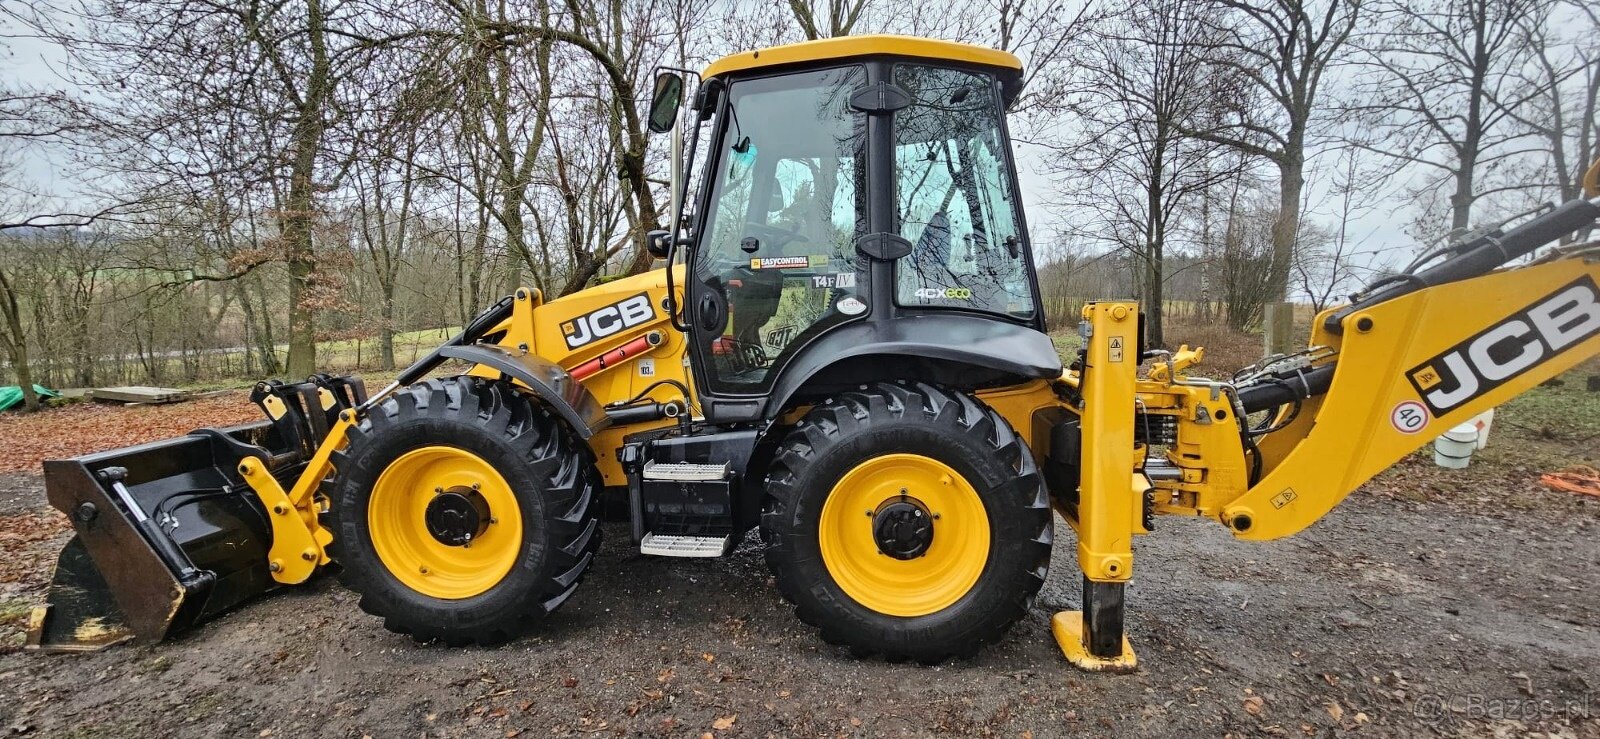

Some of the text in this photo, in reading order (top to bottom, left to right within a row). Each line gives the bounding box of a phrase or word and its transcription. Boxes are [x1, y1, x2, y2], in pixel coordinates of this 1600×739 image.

[761, 257, 807, 267] EASYCONTROL
[915, 288, 971, 299] 4CXeco
[567, 295, 653, 347] JCB
[1426, 285, 1600, 410] JCB
[1399, 408, 1422, 428] 40
